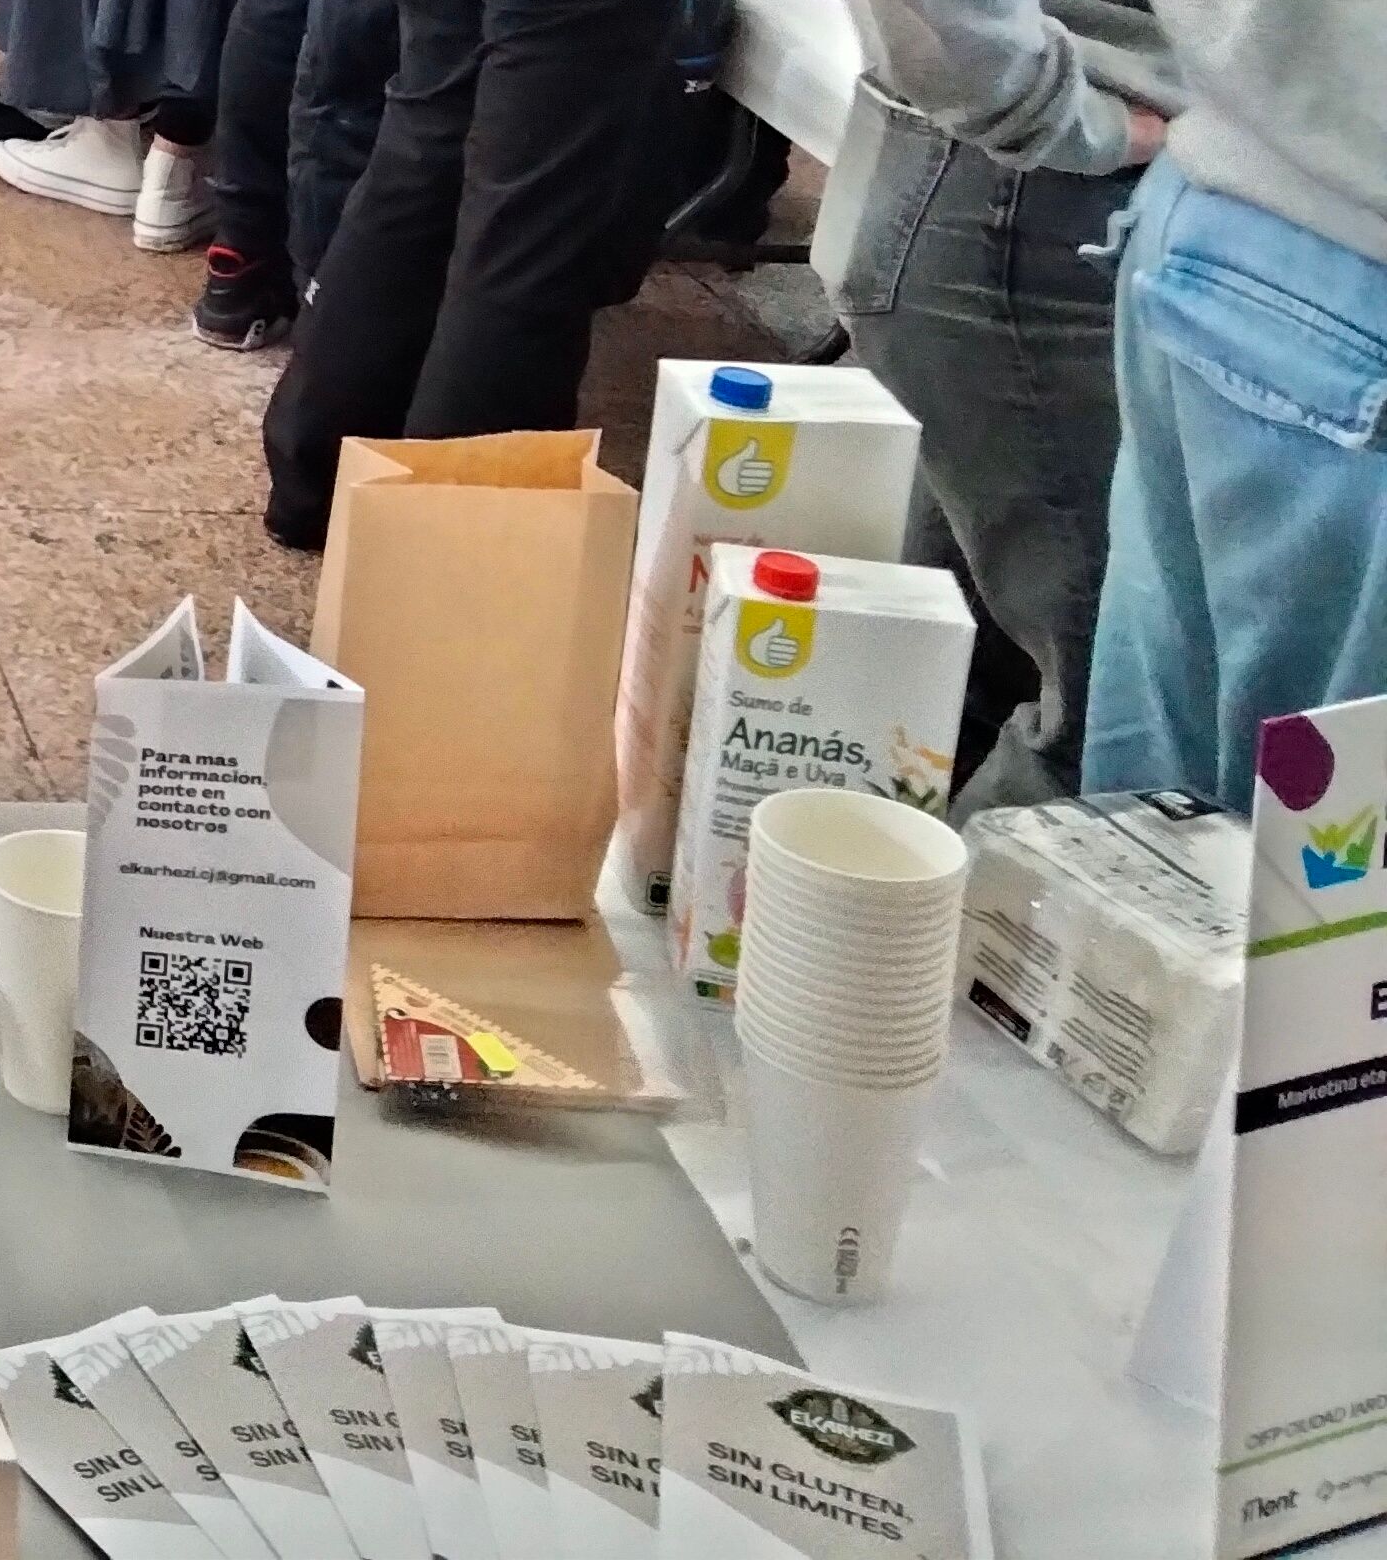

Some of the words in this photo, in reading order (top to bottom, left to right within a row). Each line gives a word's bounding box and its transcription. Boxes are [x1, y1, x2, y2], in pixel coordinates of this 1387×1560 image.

[730, 690, 784, 712] Sumo
[788, 696, 813, 716] de
[141, 747, 191, 765] Para
[195, 754, 238, 768] mas
[725, 717, 872, 773] Ananás,
[721, 750, 779, 780] Maçã
[786, 765, 798, 779] e
[805, 762, 846, 787] Uva
[138, 784, 197, 798] ponte
[201, 788, 225, 800] en
[137, 801, 231, 817] contacto
[235, 807, 271, 820] con
[136, 816, 228, 834] nosotros
[139, 926, 216, 946] Nuestra
[220, 933, 264, 950] Web
[329, 1408, 382, 1428] SIN
[230, 1423, 282, 1443] SIN
[343, 1432, 395, 1452] SIN
[74, 1454, 117, 1480] SIN
[248, 1447, 300, 1468] SIN
[586, 1440, 640, 1469] SIN
[707, 1441, 762, 1472] SIN
[97, 1475, 145, 1504] SIN
[589, 1463, 645, 1494] SIN
[707, 1463, 763, 1495] SIN
